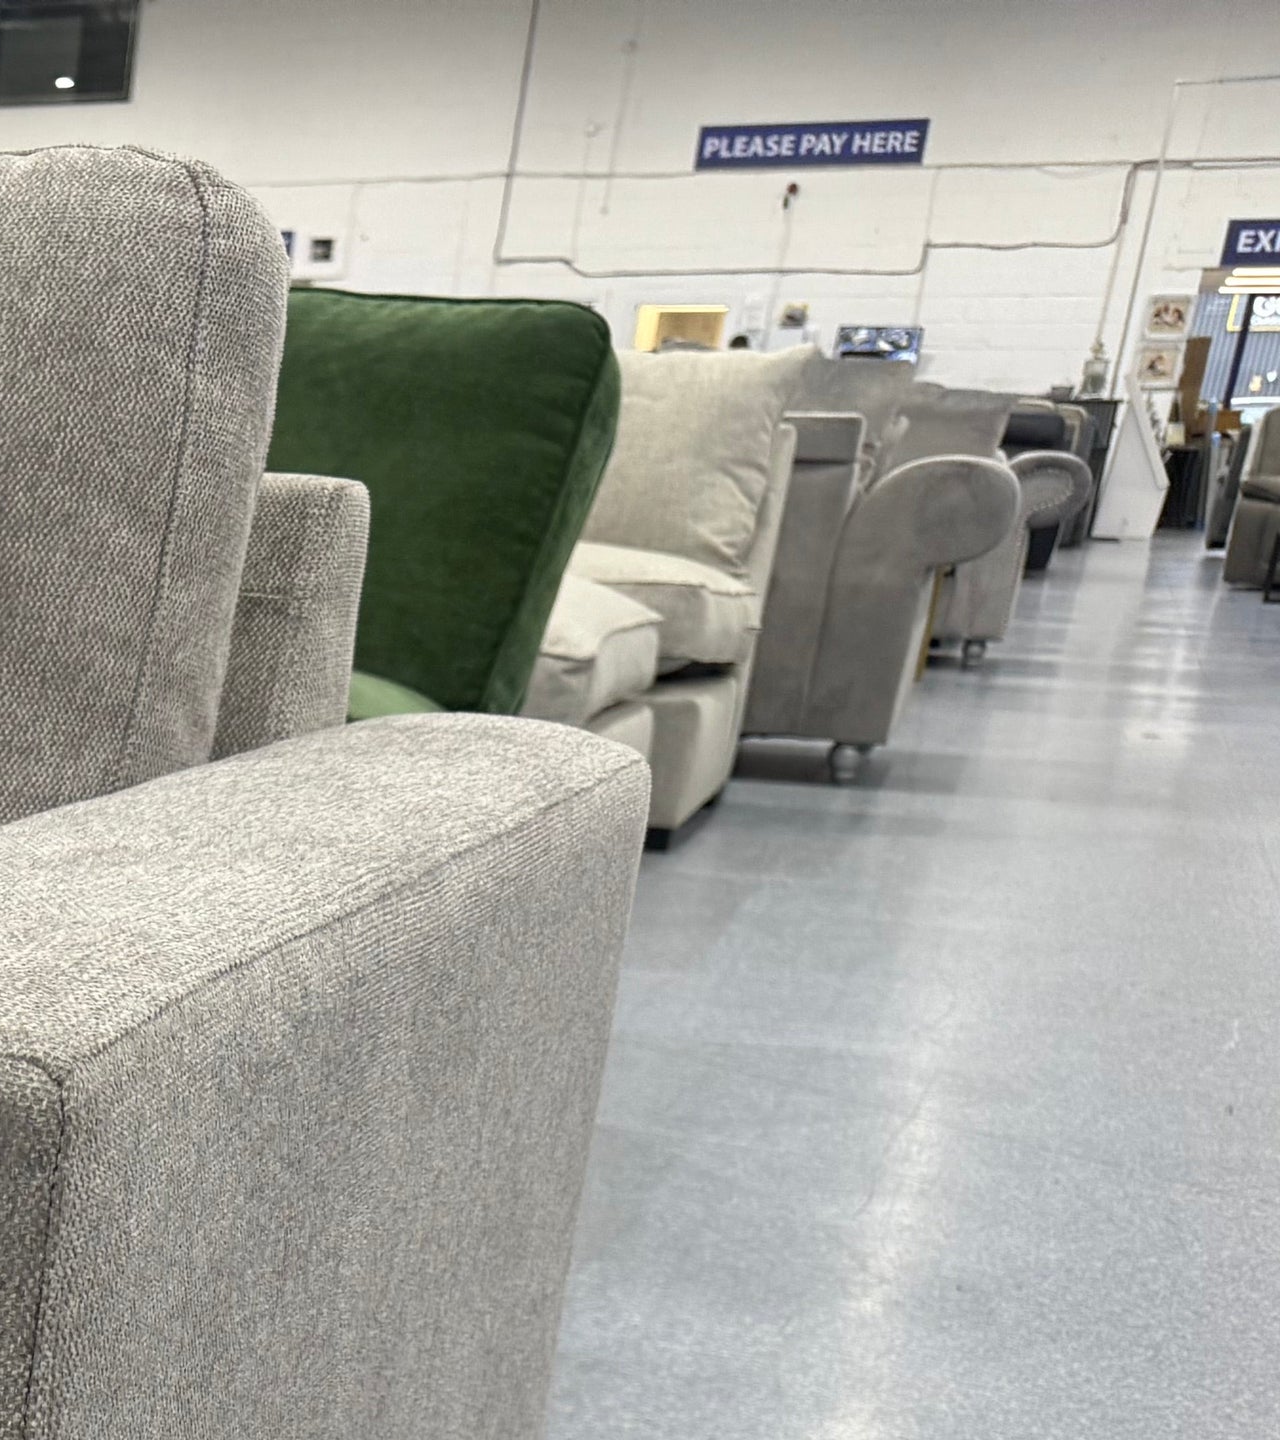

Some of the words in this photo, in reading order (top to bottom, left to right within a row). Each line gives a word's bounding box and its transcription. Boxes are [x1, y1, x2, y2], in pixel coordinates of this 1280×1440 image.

[703, 134, 795, 159] PLEASE
[798, 132, 849, 156] PAY
[851, 129, 921, 154] HERE
